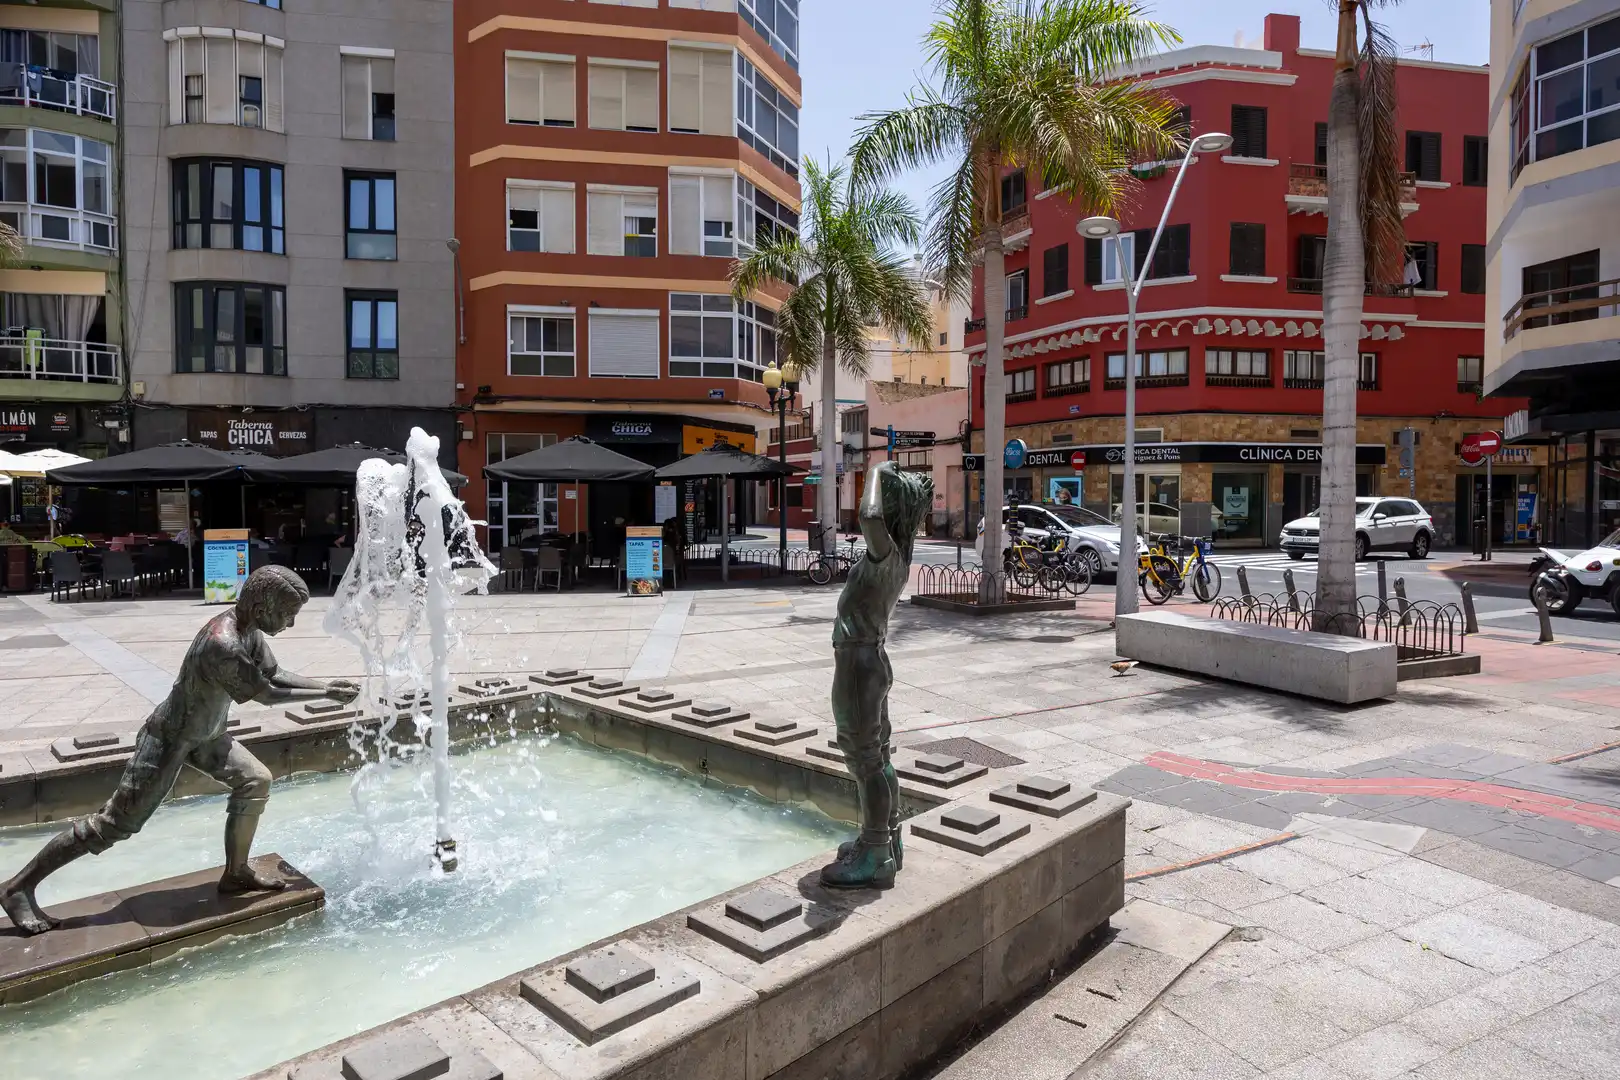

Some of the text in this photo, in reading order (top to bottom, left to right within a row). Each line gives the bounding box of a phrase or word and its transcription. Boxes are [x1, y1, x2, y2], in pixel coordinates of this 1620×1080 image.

[0, 409, 36, 426] LMÓN
[227, 419, 273, 430] Taberna
[611, 425, 653, 433] CHICA
[228, 429, 274, 445] CHICA
[279, 431, 307, 439] CERVEZAS
[1029, 453, 1066, 465] DENTAL
[1239, 447, 1323, 460] CLÍNICA DEN
